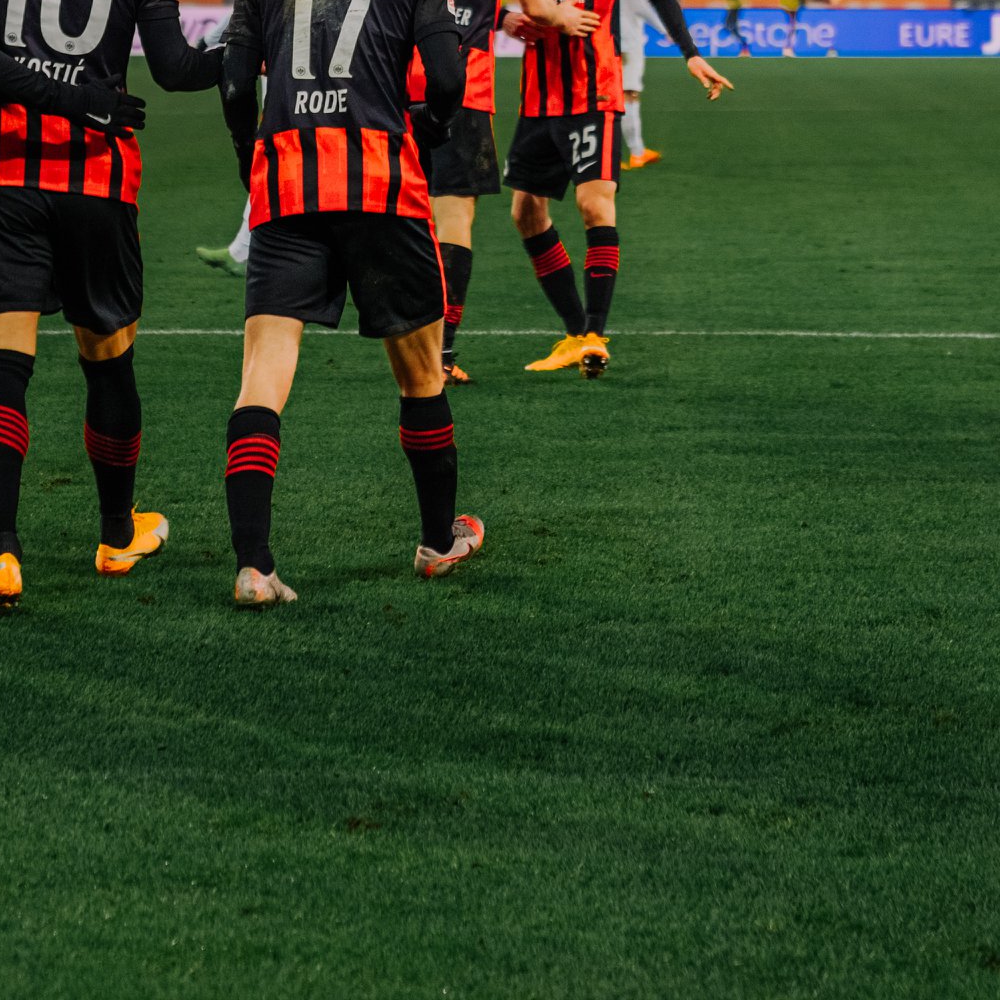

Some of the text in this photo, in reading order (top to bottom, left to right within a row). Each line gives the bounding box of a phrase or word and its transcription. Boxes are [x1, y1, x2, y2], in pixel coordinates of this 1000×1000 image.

[900, 22, 971, 48] EURE
[294, 88, 348, 115] RODE
[568, 124, 598, 167] 25
